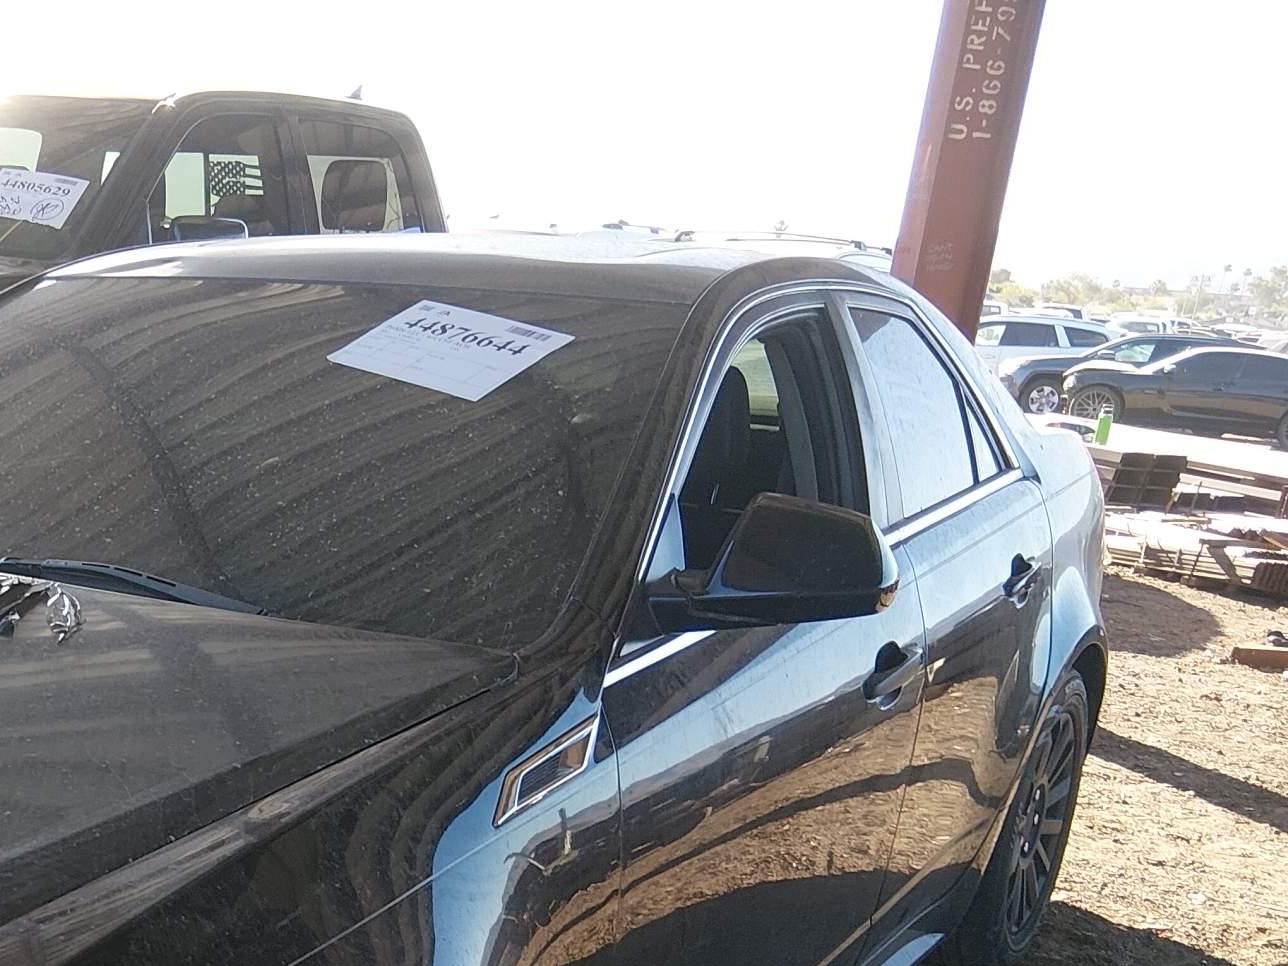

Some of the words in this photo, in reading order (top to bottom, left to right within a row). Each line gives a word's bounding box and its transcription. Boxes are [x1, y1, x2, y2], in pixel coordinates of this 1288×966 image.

[972, 0, 1017, 138] 1-866-79
[948, 87, 974, 140] U.S.
[1, 178, 71, 198] 44805629
[404, 317, 531, 356] 44876644
